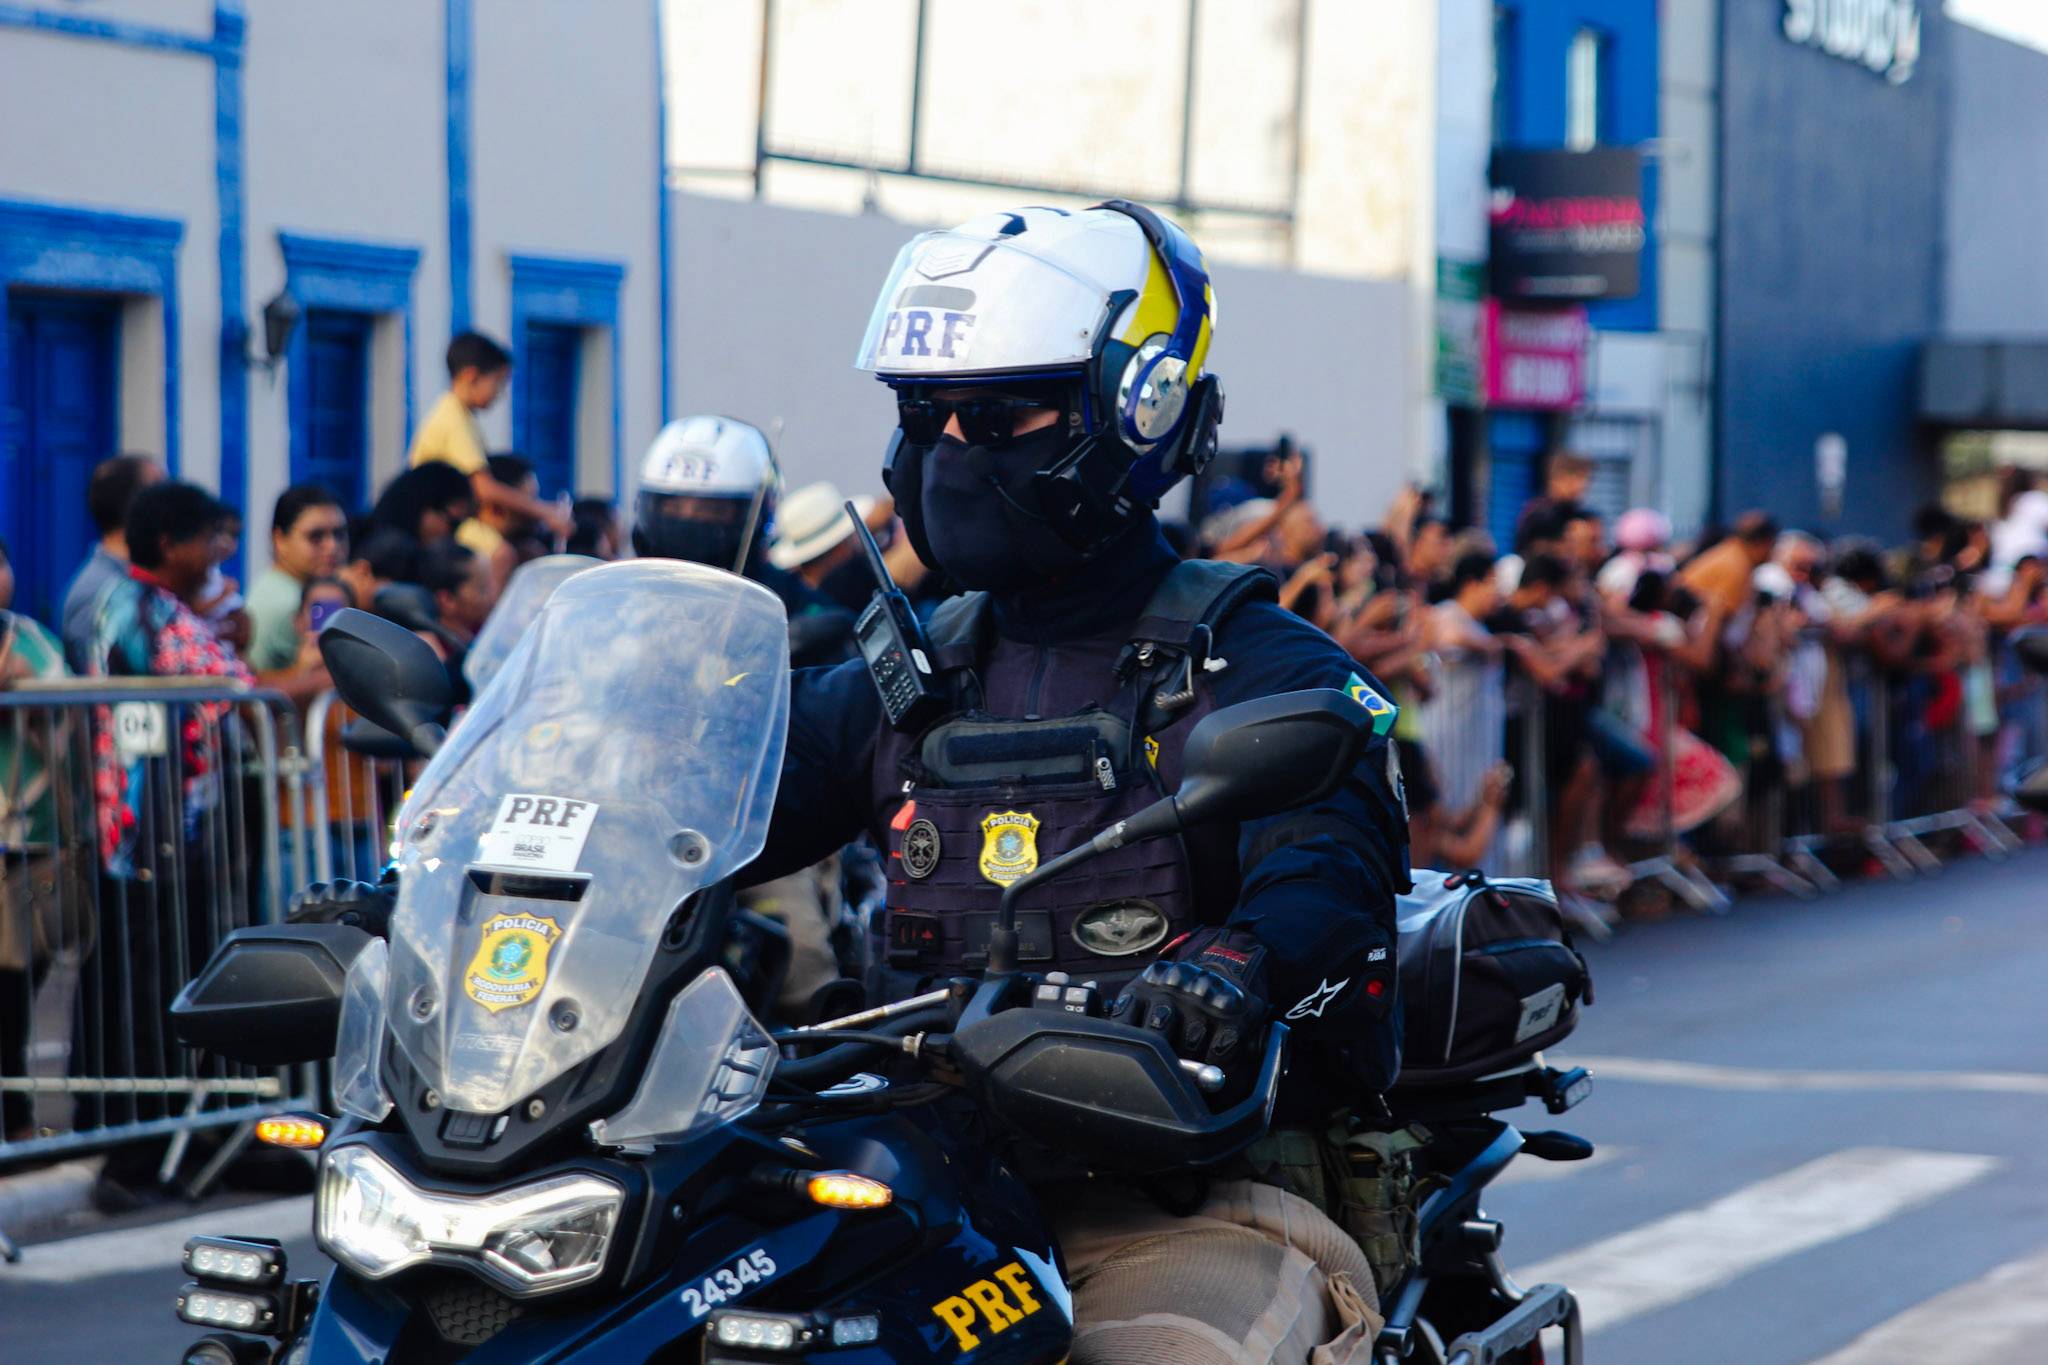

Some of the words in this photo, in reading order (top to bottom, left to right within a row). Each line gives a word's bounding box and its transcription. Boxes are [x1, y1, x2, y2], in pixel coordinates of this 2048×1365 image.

[879, 310, 977, 358] PRF
[504, 797, 587, 828] PRF
[681, 1248, 777, 1318] 24345
[931, 1262, 1042, 1353] PRF
